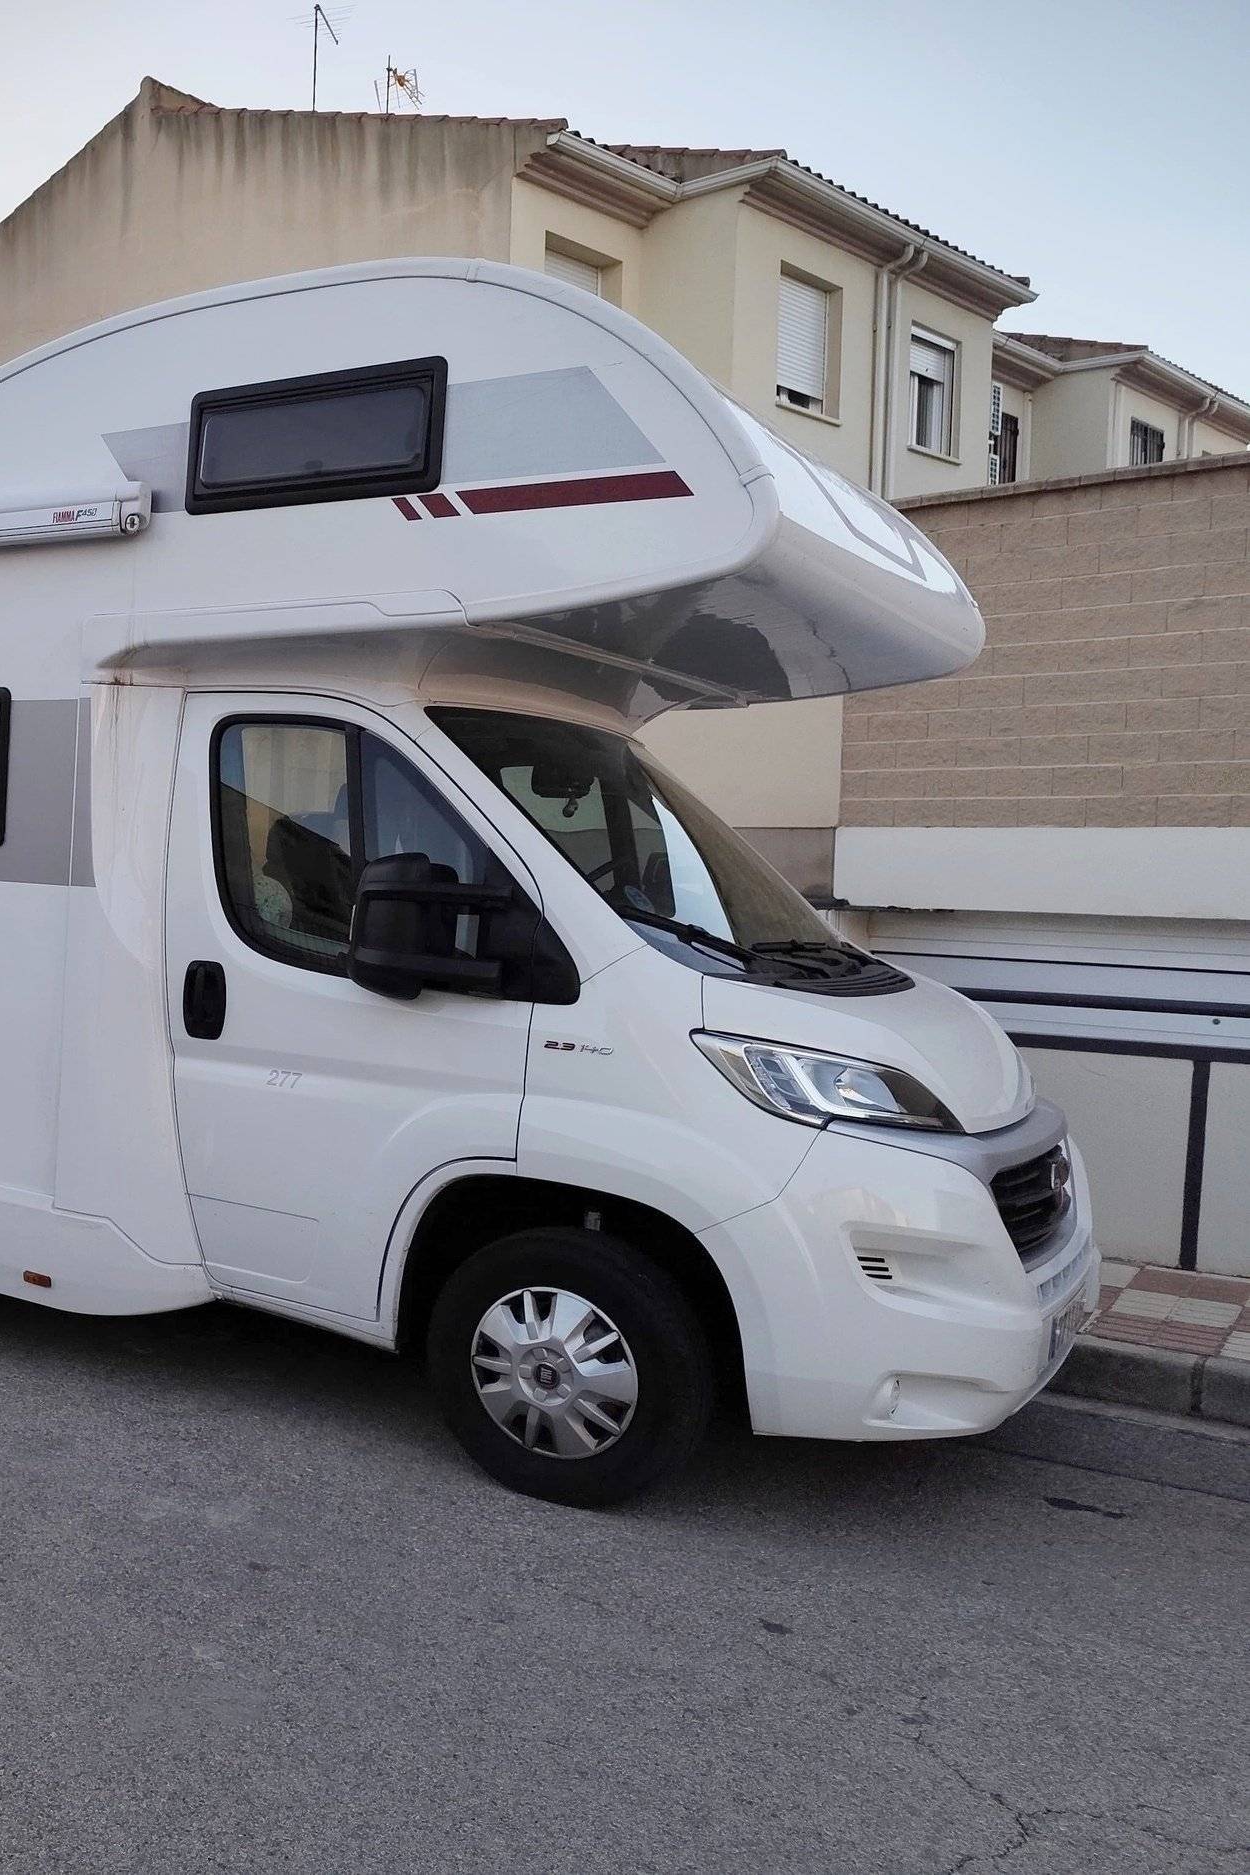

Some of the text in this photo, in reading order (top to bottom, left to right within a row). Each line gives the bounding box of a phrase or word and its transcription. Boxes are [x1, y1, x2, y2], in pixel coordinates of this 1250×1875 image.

[52, 510, 75, 524] FIAMMA
[579, 1044, 614, 1056] 140
[265, 1069, 303, 1088] 277
